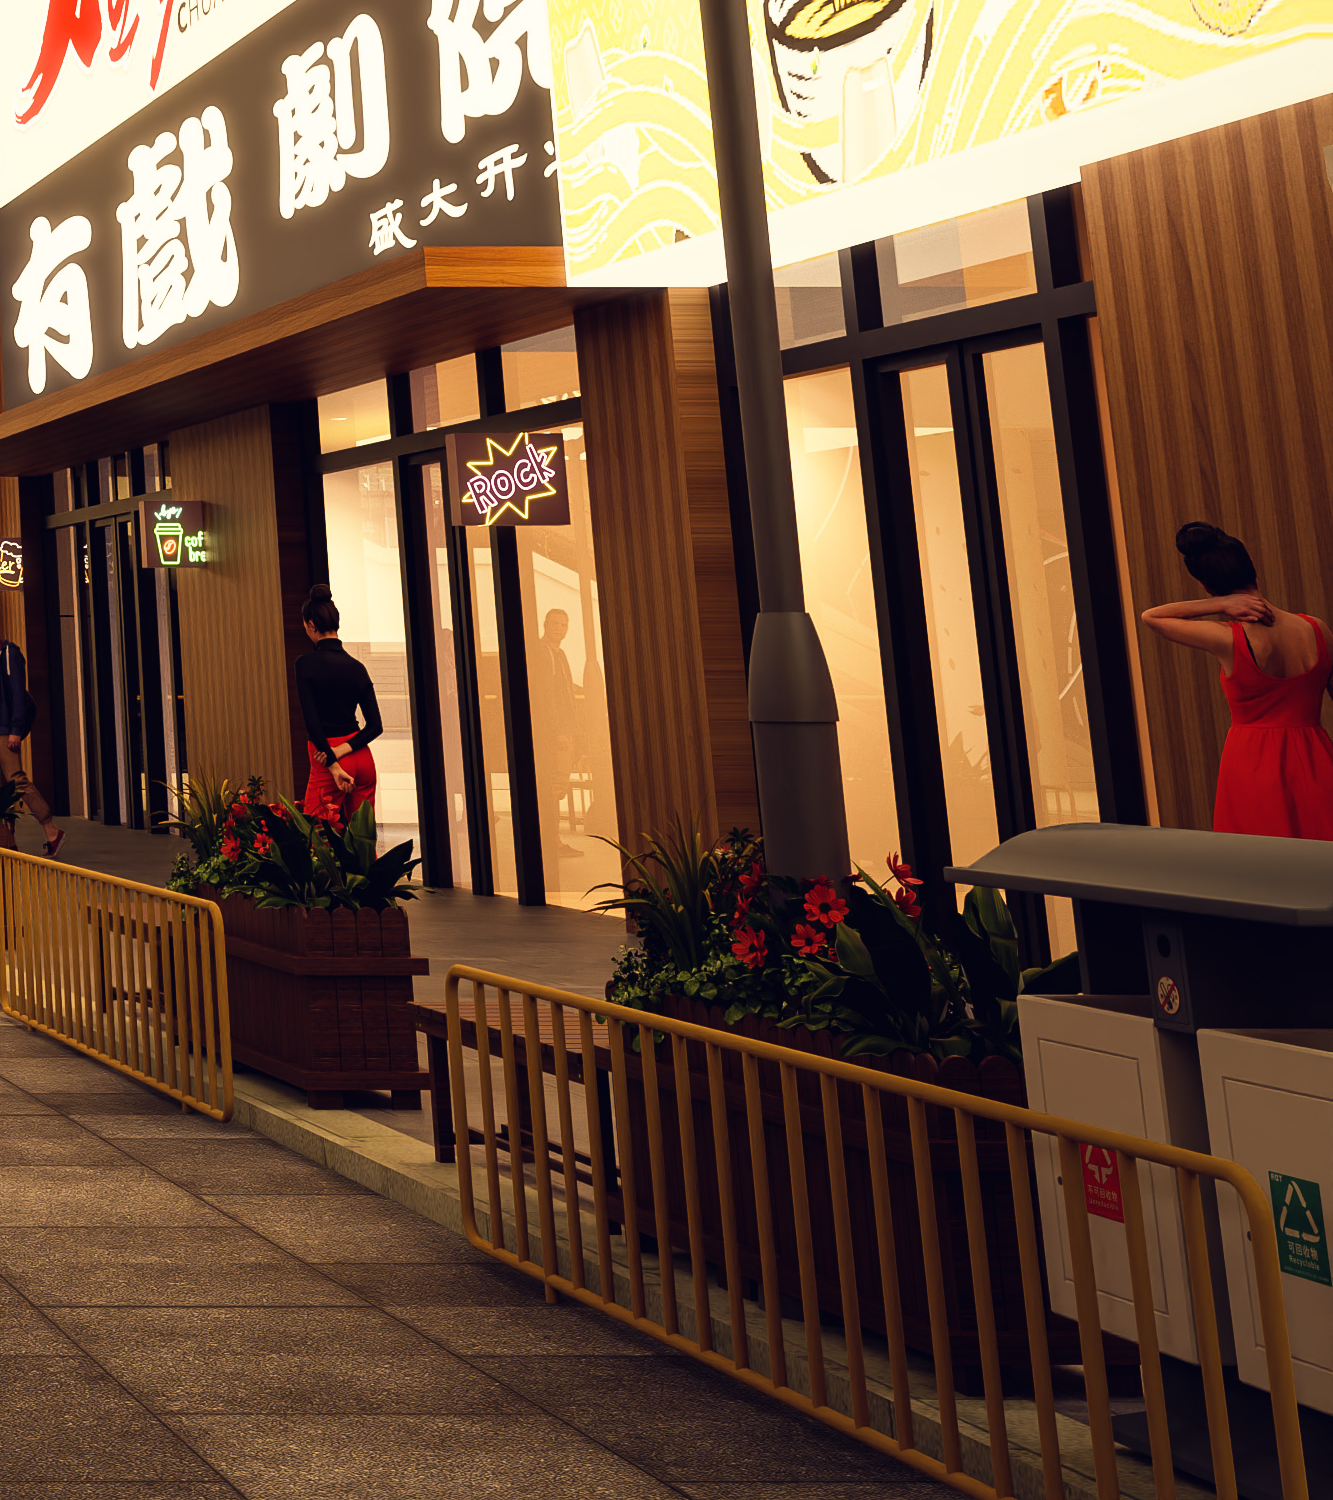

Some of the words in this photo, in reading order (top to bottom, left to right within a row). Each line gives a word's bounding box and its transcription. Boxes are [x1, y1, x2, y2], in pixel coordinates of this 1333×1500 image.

[1087, 1184, 1118, 1202] 不可回收物
[1287, 1241, 1319, 1261] 可回收物
[1289, 1255, 1320, 1271] Recyclable
